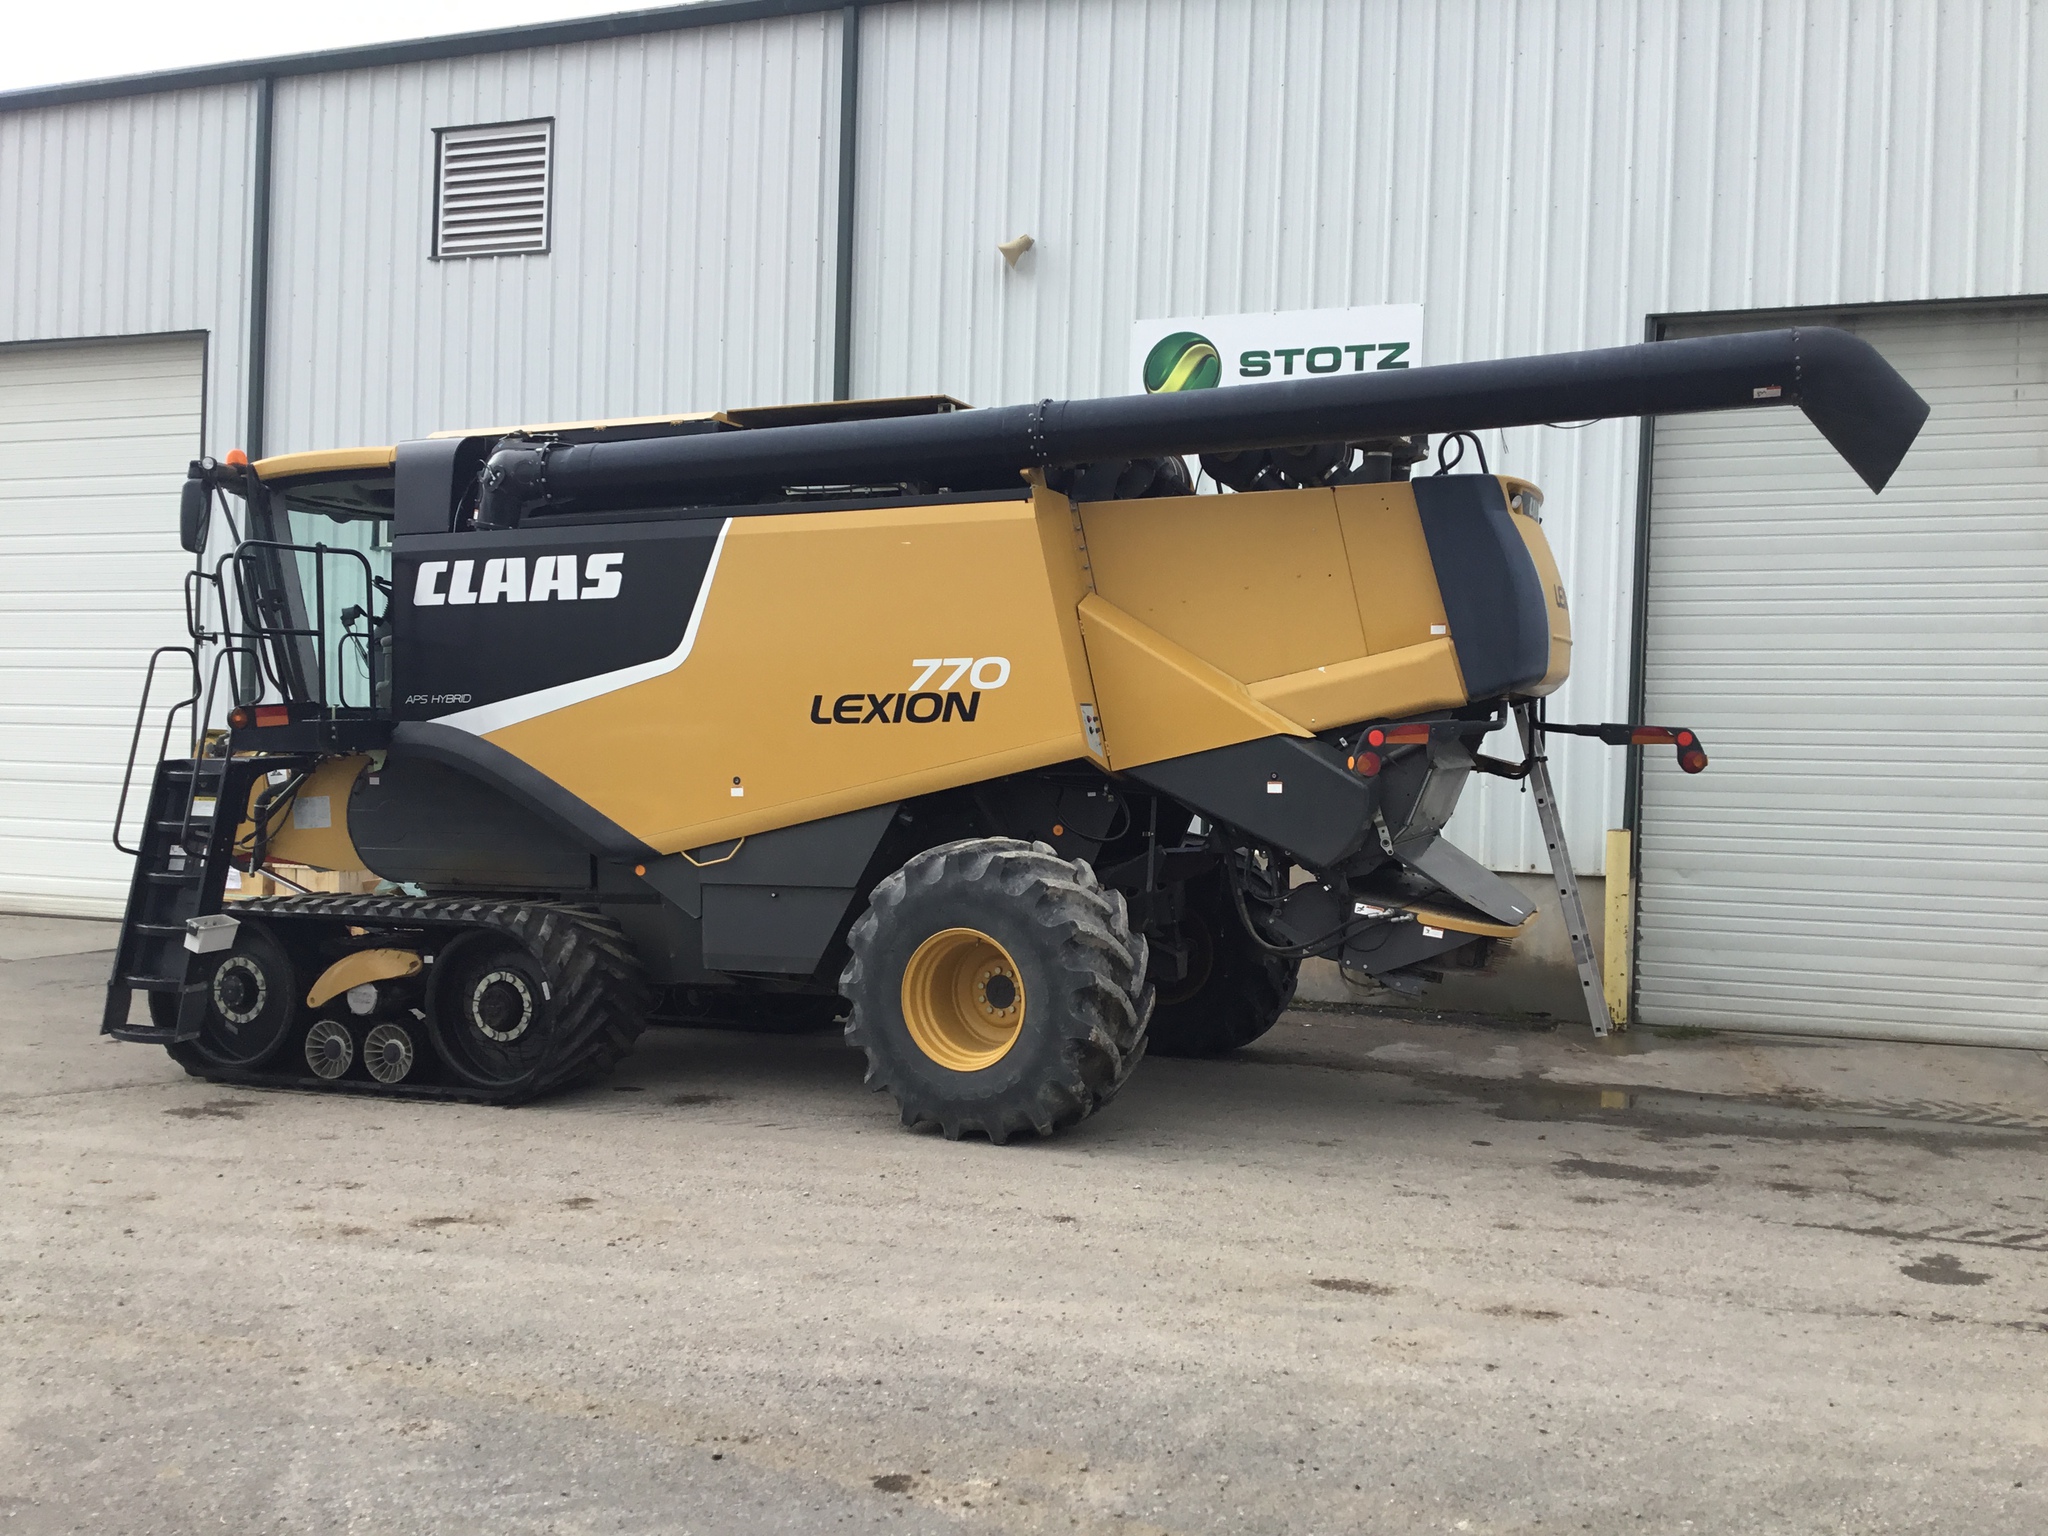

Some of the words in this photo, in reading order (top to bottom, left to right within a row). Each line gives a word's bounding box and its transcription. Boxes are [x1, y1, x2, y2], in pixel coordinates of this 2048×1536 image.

[1239, 342, 1410, 378] STOTZ
[413, 552, 625, 606] CLAAS
[908, 656, 1011, 691] 770
[405, 694, 429, 705] APS
[430, 693, 472, 704] HYBRID
[810, 691, 981, 724] LEXION
